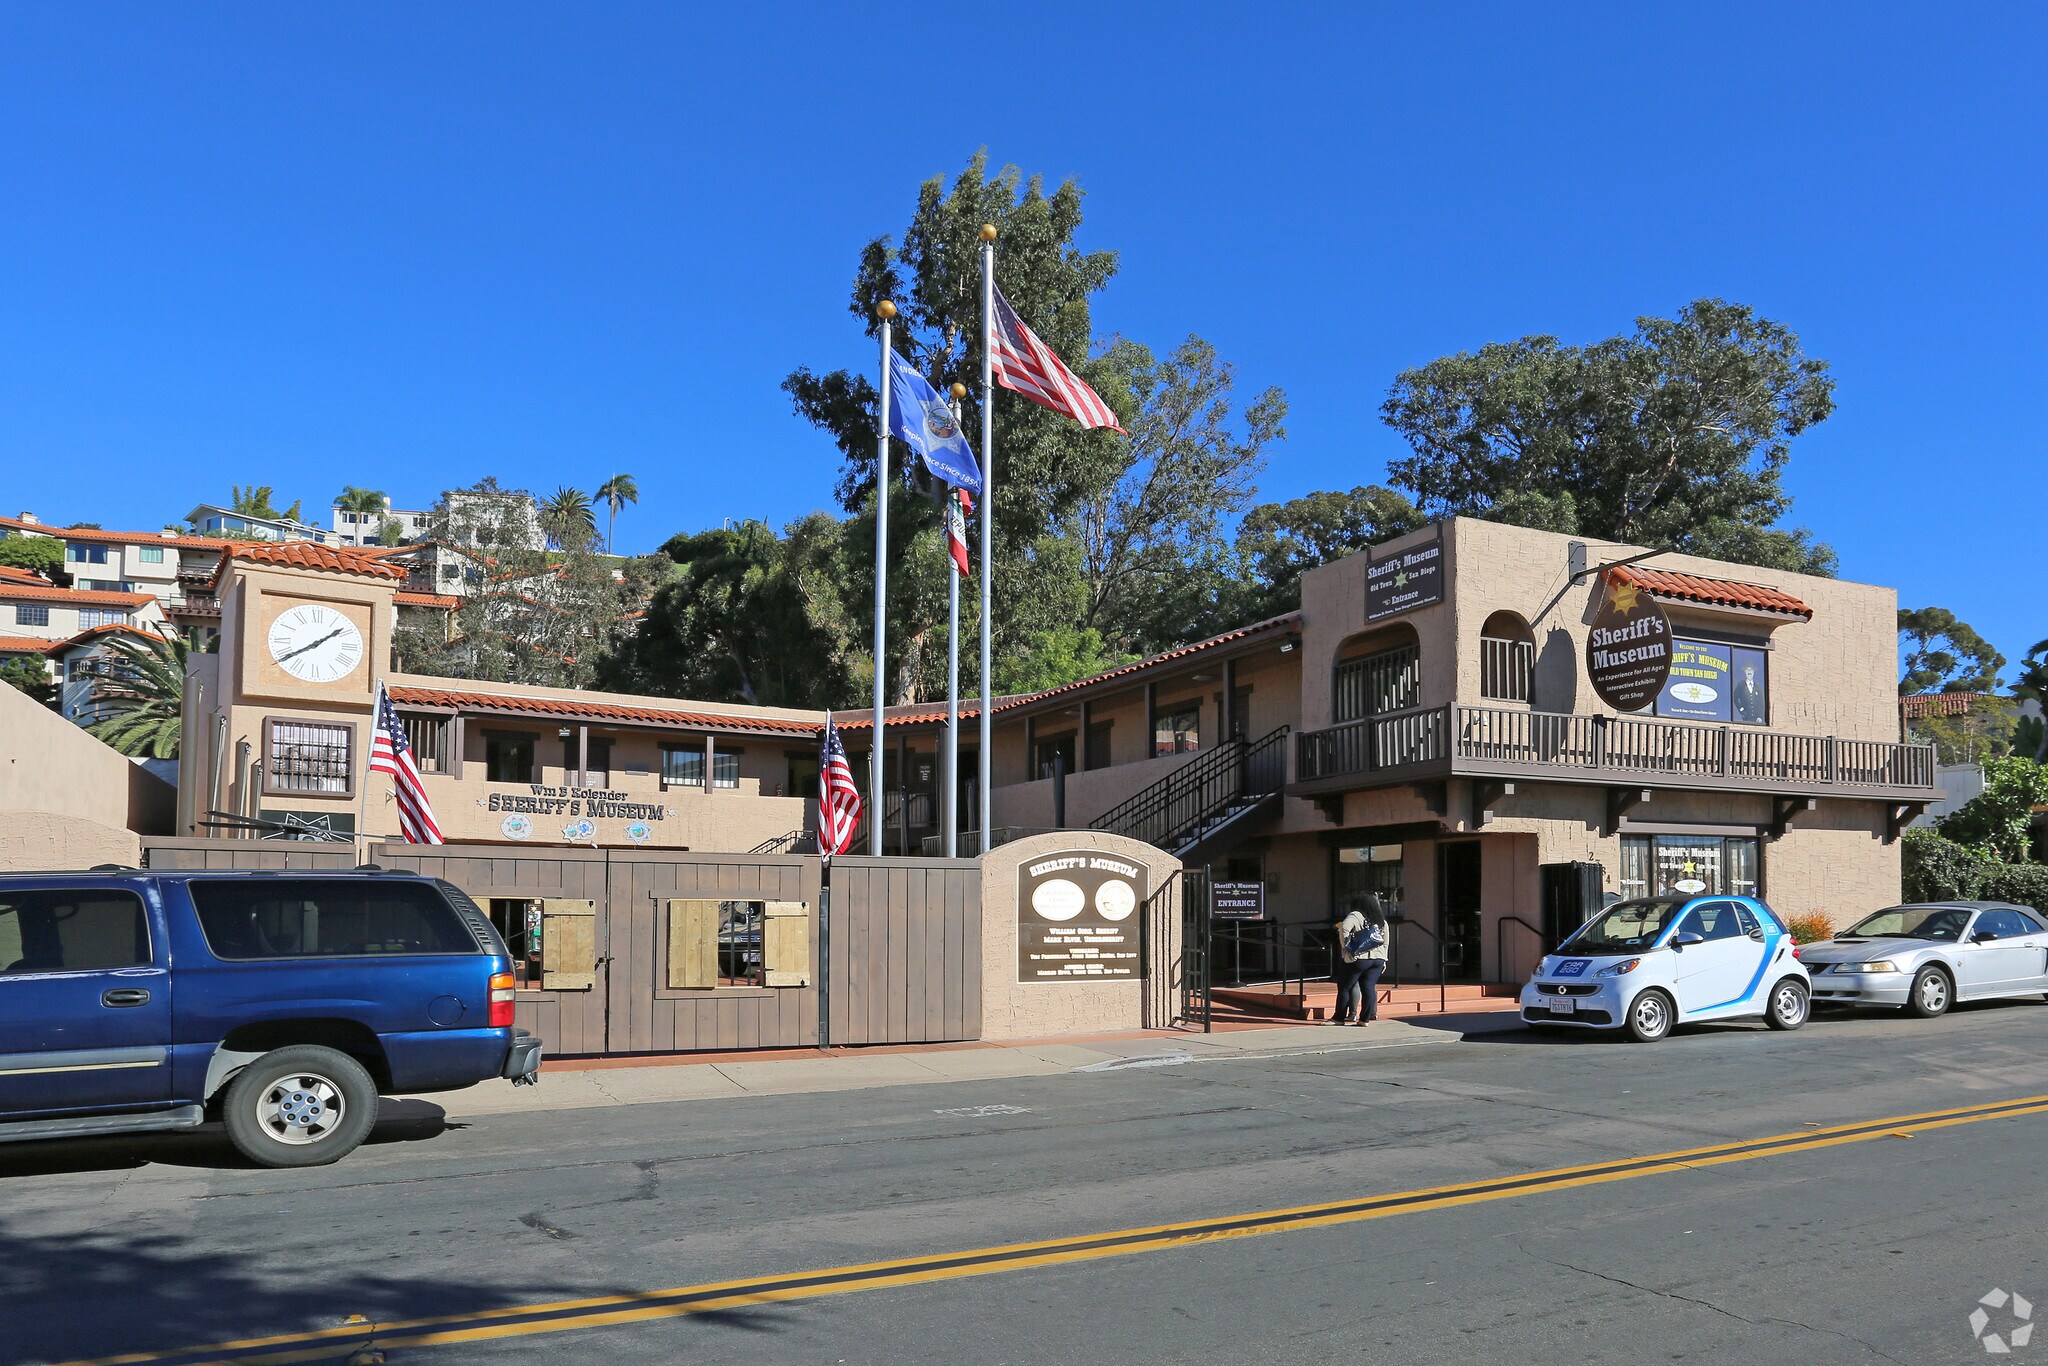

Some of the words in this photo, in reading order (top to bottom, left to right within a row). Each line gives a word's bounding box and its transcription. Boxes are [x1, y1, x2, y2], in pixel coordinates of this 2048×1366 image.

[1368, 559, 1401, 580] Sheriff's
[1403, 548, 1439, 567] Museum
[1370, 583, 1379, 592] Old
[1380, 581, 1393, 589] Town
[1420, 566, 1436, 576] Diego
[1391, 590, 1419, 605] Entrance
[1592, 616, 1664, 648] Sheriff's
[1593, 642, 1666, 670] Museum
[1671, 652, 1695, 664] RIFF'S
[1698, 654, 1729, 673] MUSEUM
[1605, 669, 1633, 681] Experience
[1633, 668, 1642, 676] for
[1651, 665, 1665, 673] Ages
[1670, 667, 1679, 676] OLD
[1606, 681, 1634, 692] Interactive
[1634, 678, 1656, 687] Exhibits
[1619, 693, 1630, 701] Gift
[1630, 691, 1644, 700] Shop
[531, 785, 557, 797] Wm
[559, 787, 568, 798] B
[571, 787, 629, 801] Kolender
[488, 793, 581, 816] SHERIFF'S
[587, 800, 665, 820] MUSEUM
[1658, 847, 1690, 857] Sheriff's
[1691, 848, 1720, 857] Museum
[1029, 857, 1086, 878] SHERIFF'S
[1090, 857, 1139, 879] MUSEUM
